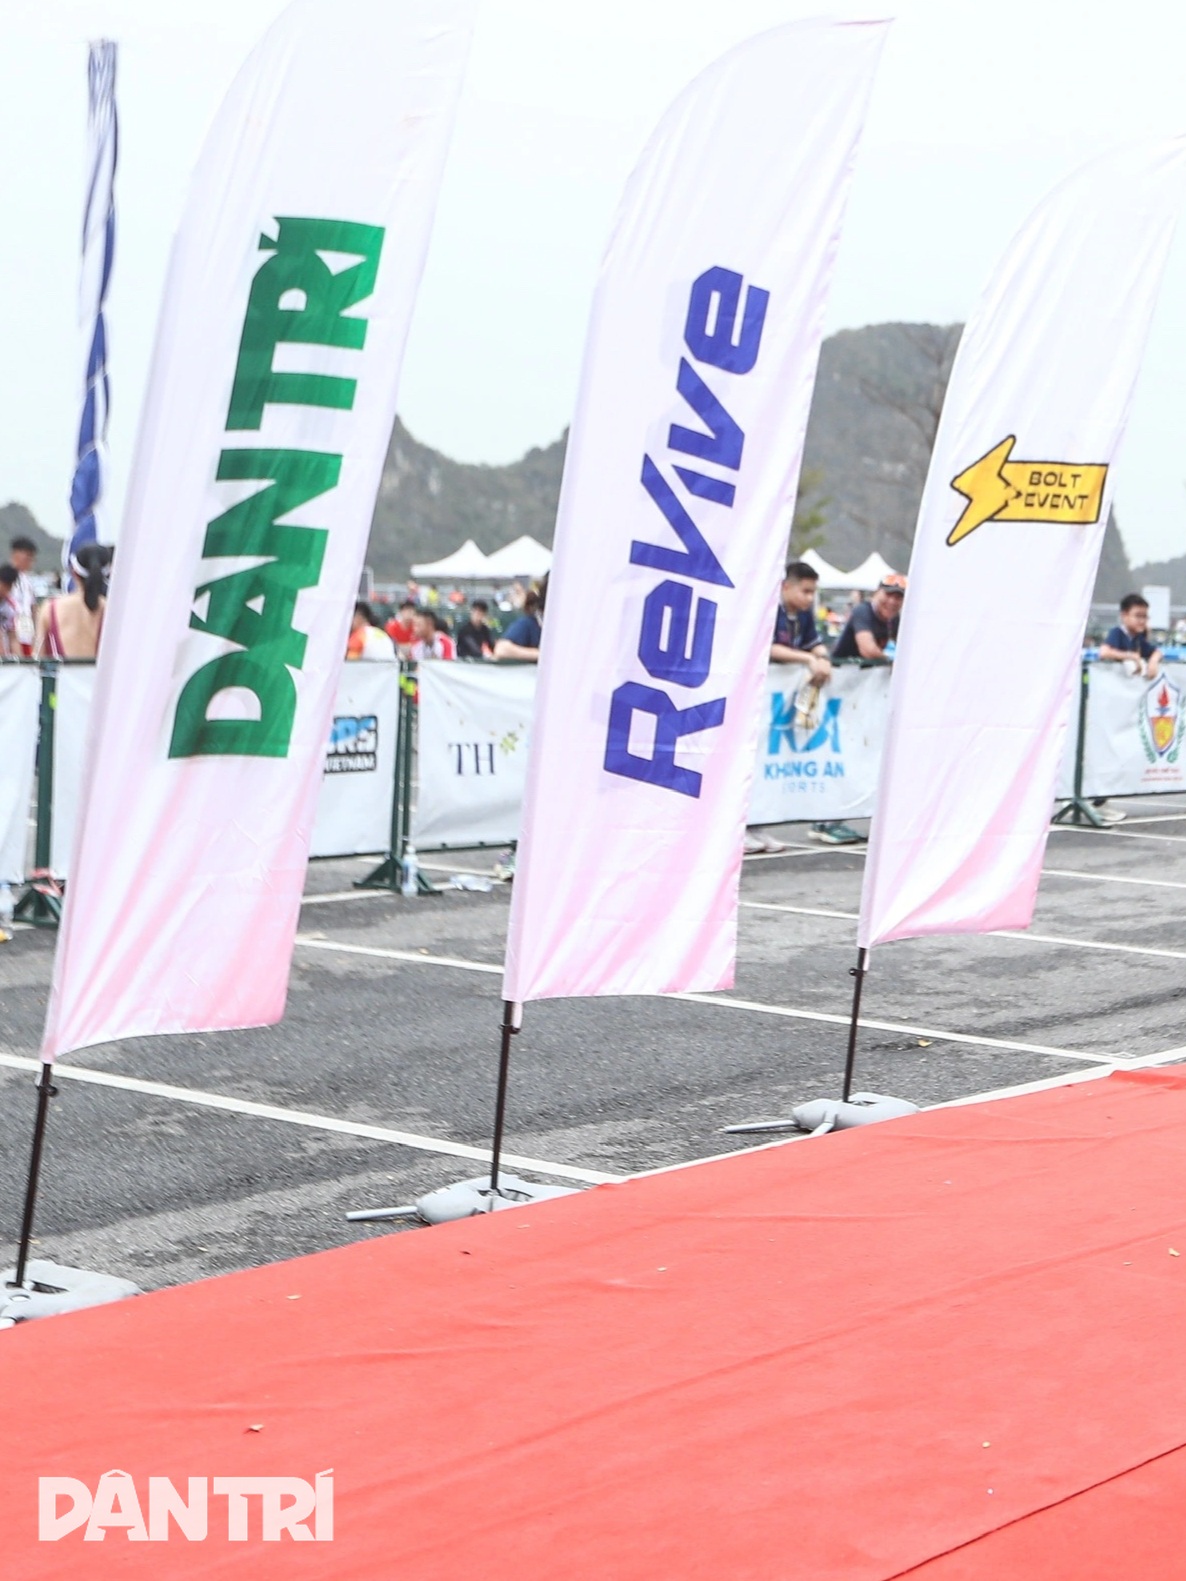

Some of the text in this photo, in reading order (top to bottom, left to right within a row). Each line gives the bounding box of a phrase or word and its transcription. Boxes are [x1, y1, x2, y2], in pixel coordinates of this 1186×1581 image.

[1029, 471, 1081, 488] BOLT
[1024, 492, 1089, 510] EVENT
[450, 743, 496, 775] TH
